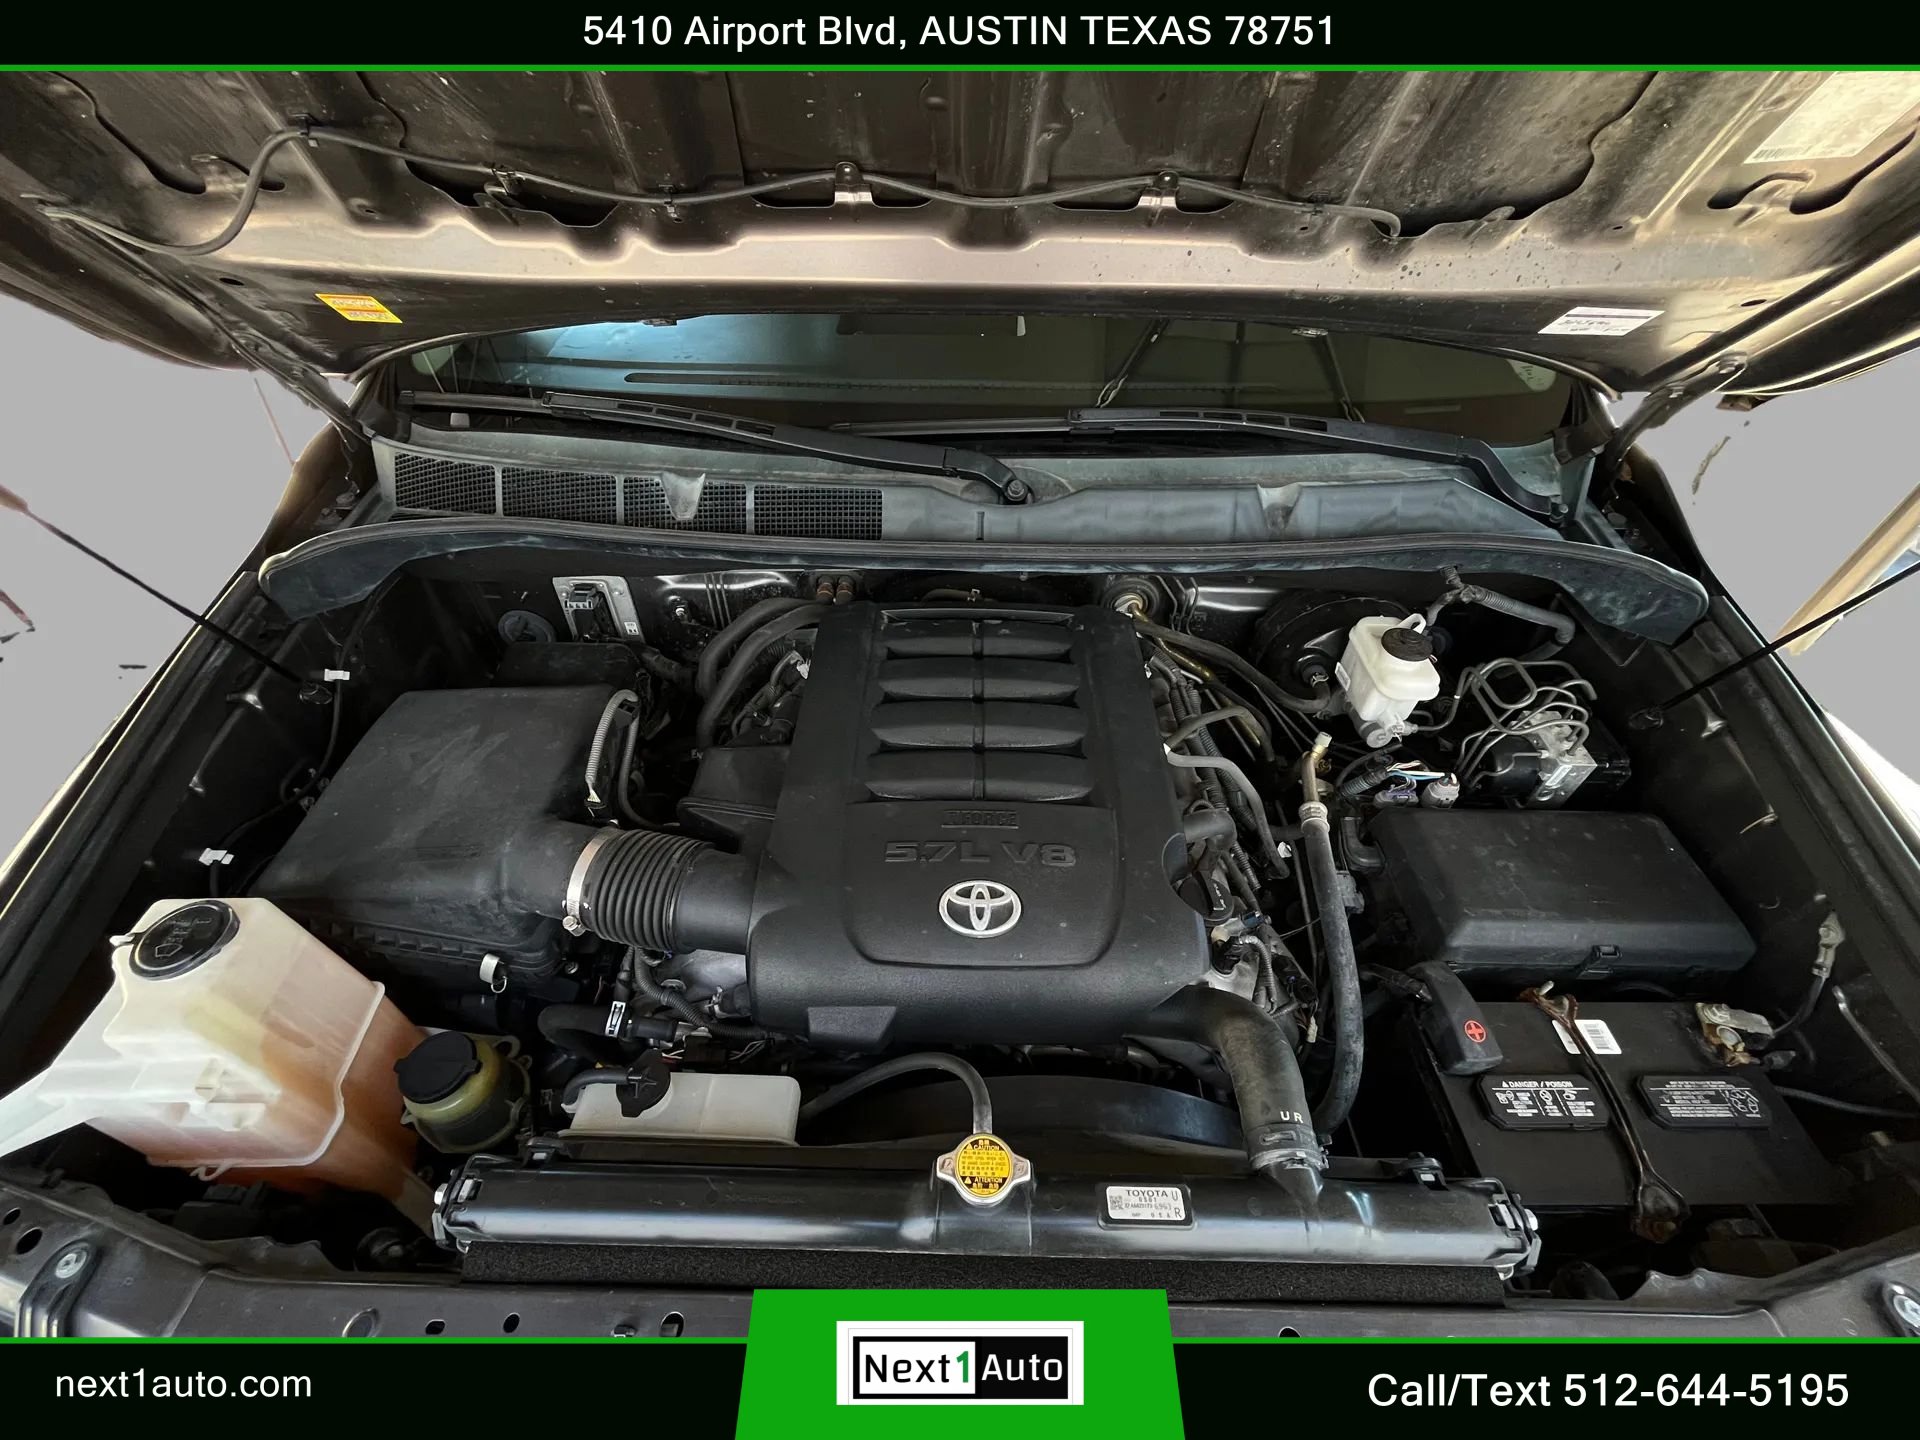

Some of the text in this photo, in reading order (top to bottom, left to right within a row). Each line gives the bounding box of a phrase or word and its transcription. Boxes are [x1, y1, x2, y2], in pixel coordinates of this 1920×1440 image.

[884, 840, 1077, 868] 5.7L V8
[1508, 1080, 1540, 1088] DANGER
[1545, 1080, 1574, 1088] POISON
[1125, 1189, 1169, 1198] TOYOTA
[1174, 1207, 1182, 1218] R
